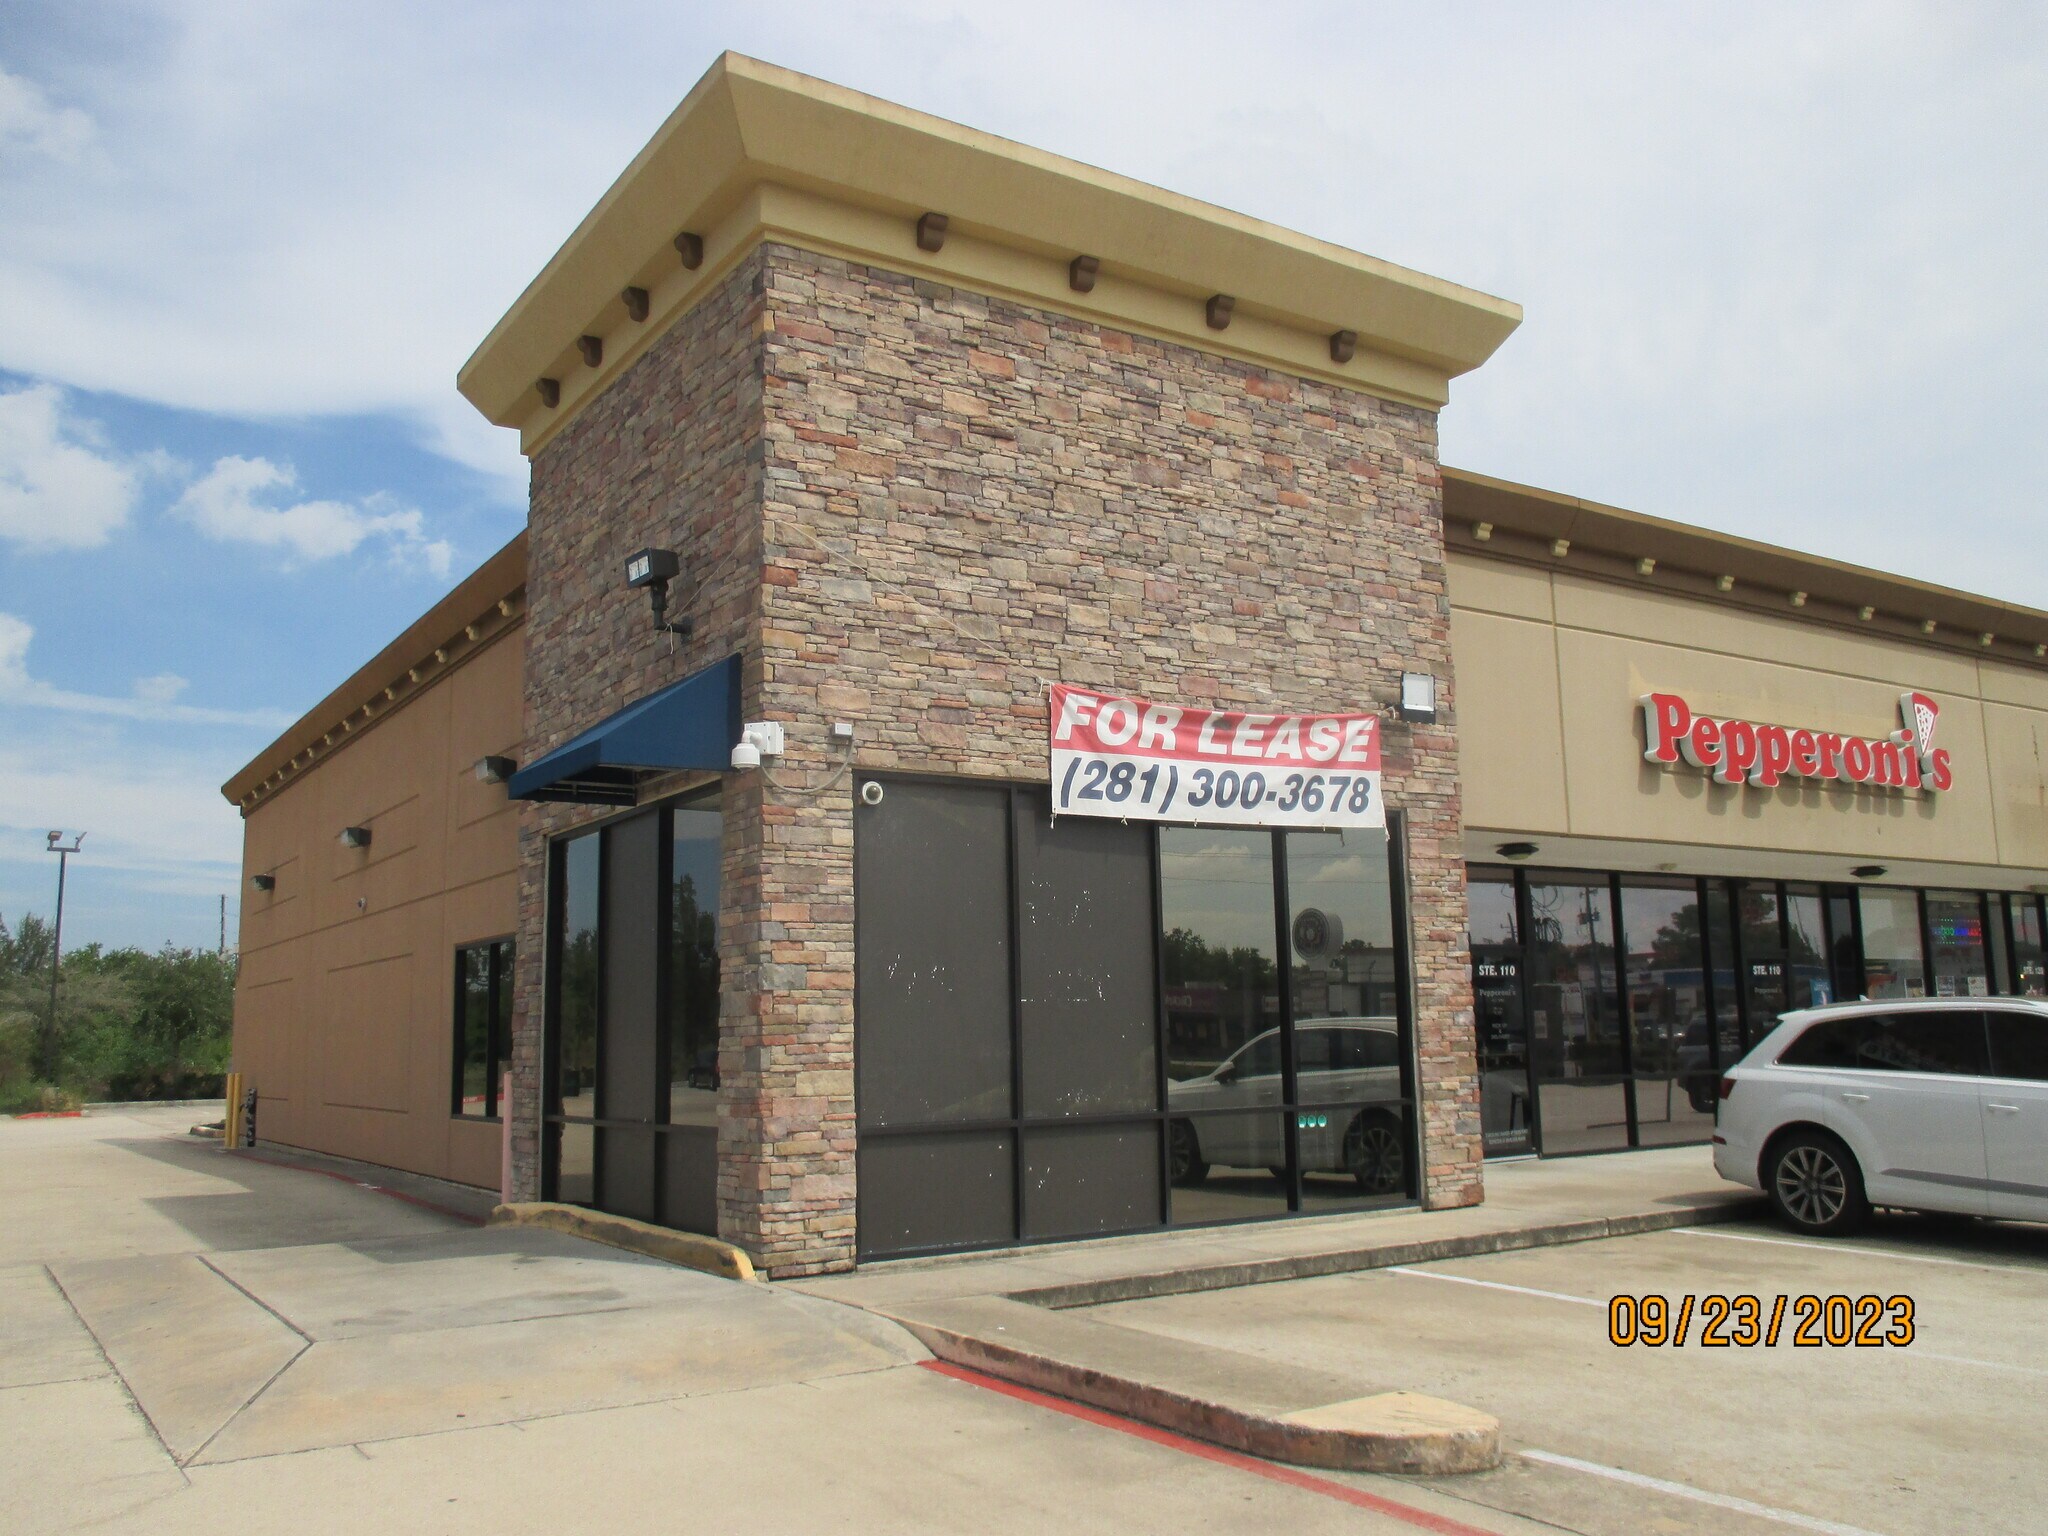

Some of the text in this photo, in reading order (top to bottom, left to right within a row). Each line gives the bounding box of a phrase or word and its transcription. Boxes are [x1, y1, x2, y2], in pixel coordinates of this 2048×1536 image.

[1055, 693, 1375, 763] FOR LEASE
[1060, 757, 1371, 814] (281) 300-3678
[1478, 964, 1516, 976] STE. 110
[1768, 965, 1781, 975] 110
